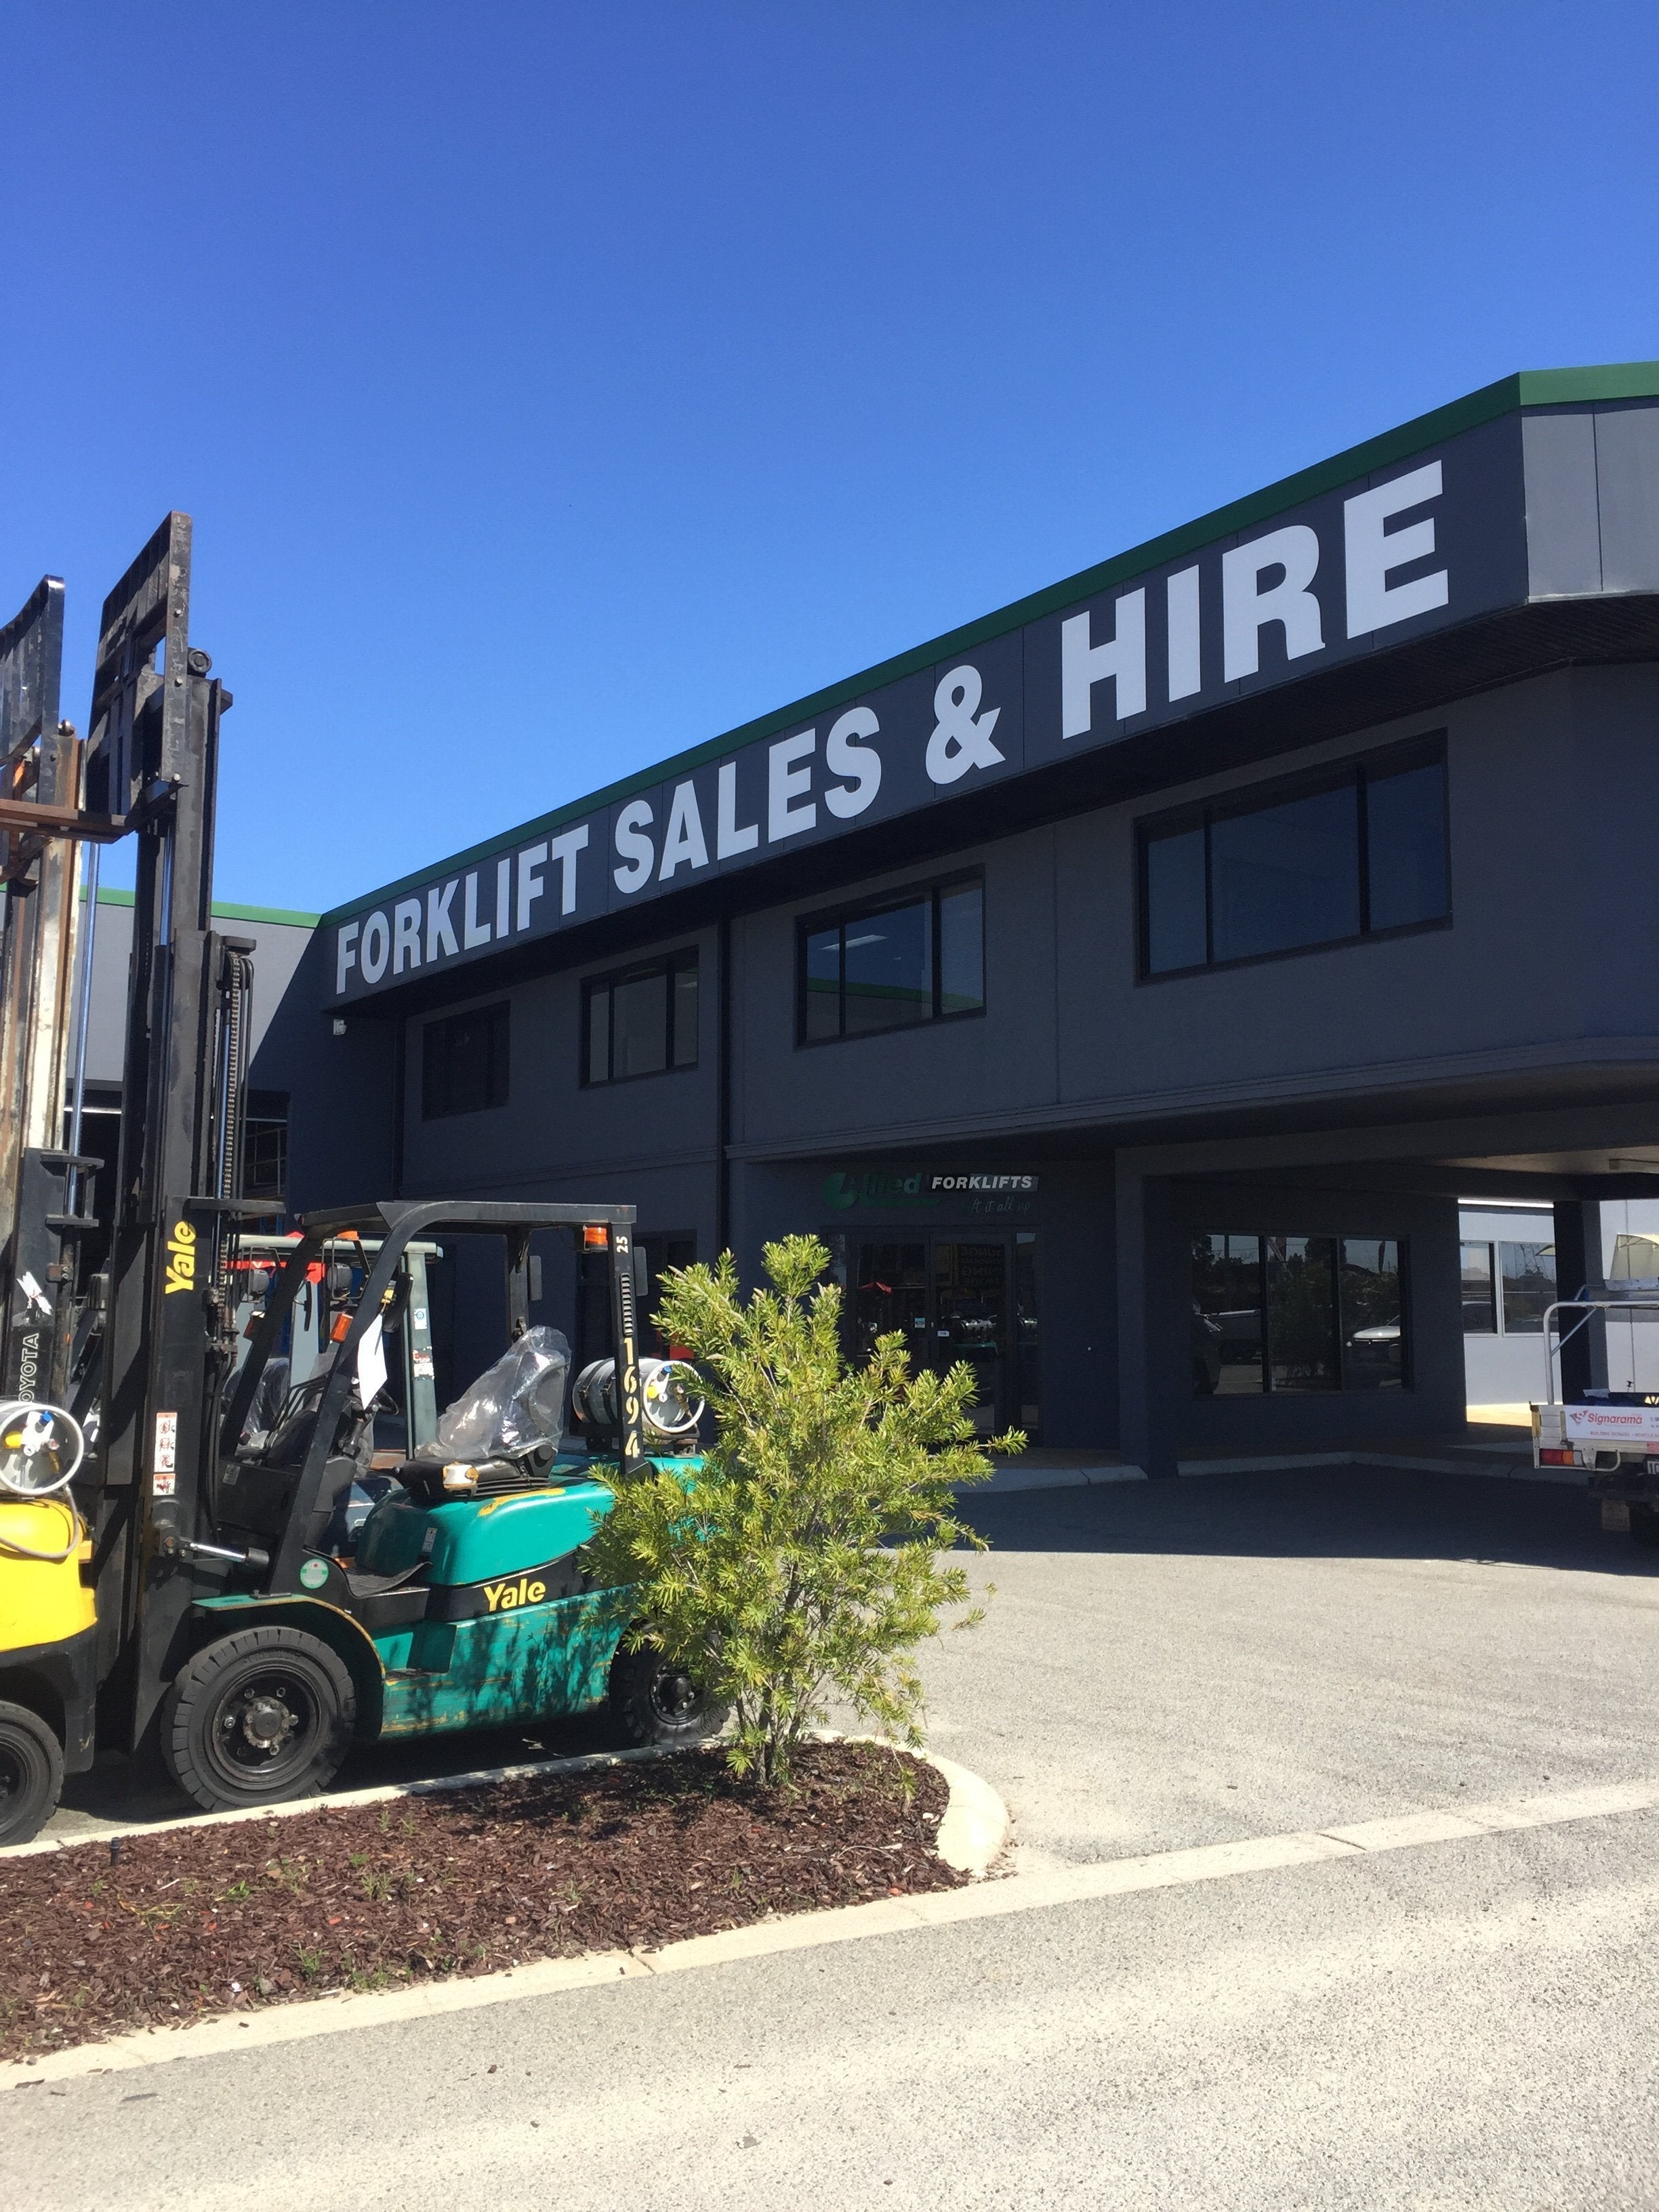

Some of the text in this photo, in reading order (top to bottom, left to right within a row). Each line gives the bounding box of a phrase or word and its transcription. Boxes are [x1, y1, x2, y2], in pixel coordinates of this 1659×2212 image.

[336, 459, 1449, 995] FORKLIFT SALES & HIRE
[931, 1175, 1033, 1189] FORKLIFTS
[165, 1221, 197, 1295] Yale
[616, 1235, 628, 1253] 25
[18, 1333, 39, 1402] OYOTA
[623, 1338, 640, 1458] 1694
[1588, 1413, 1643, 1425] Signarama
[484, 1578, 546, 1612] Yale
